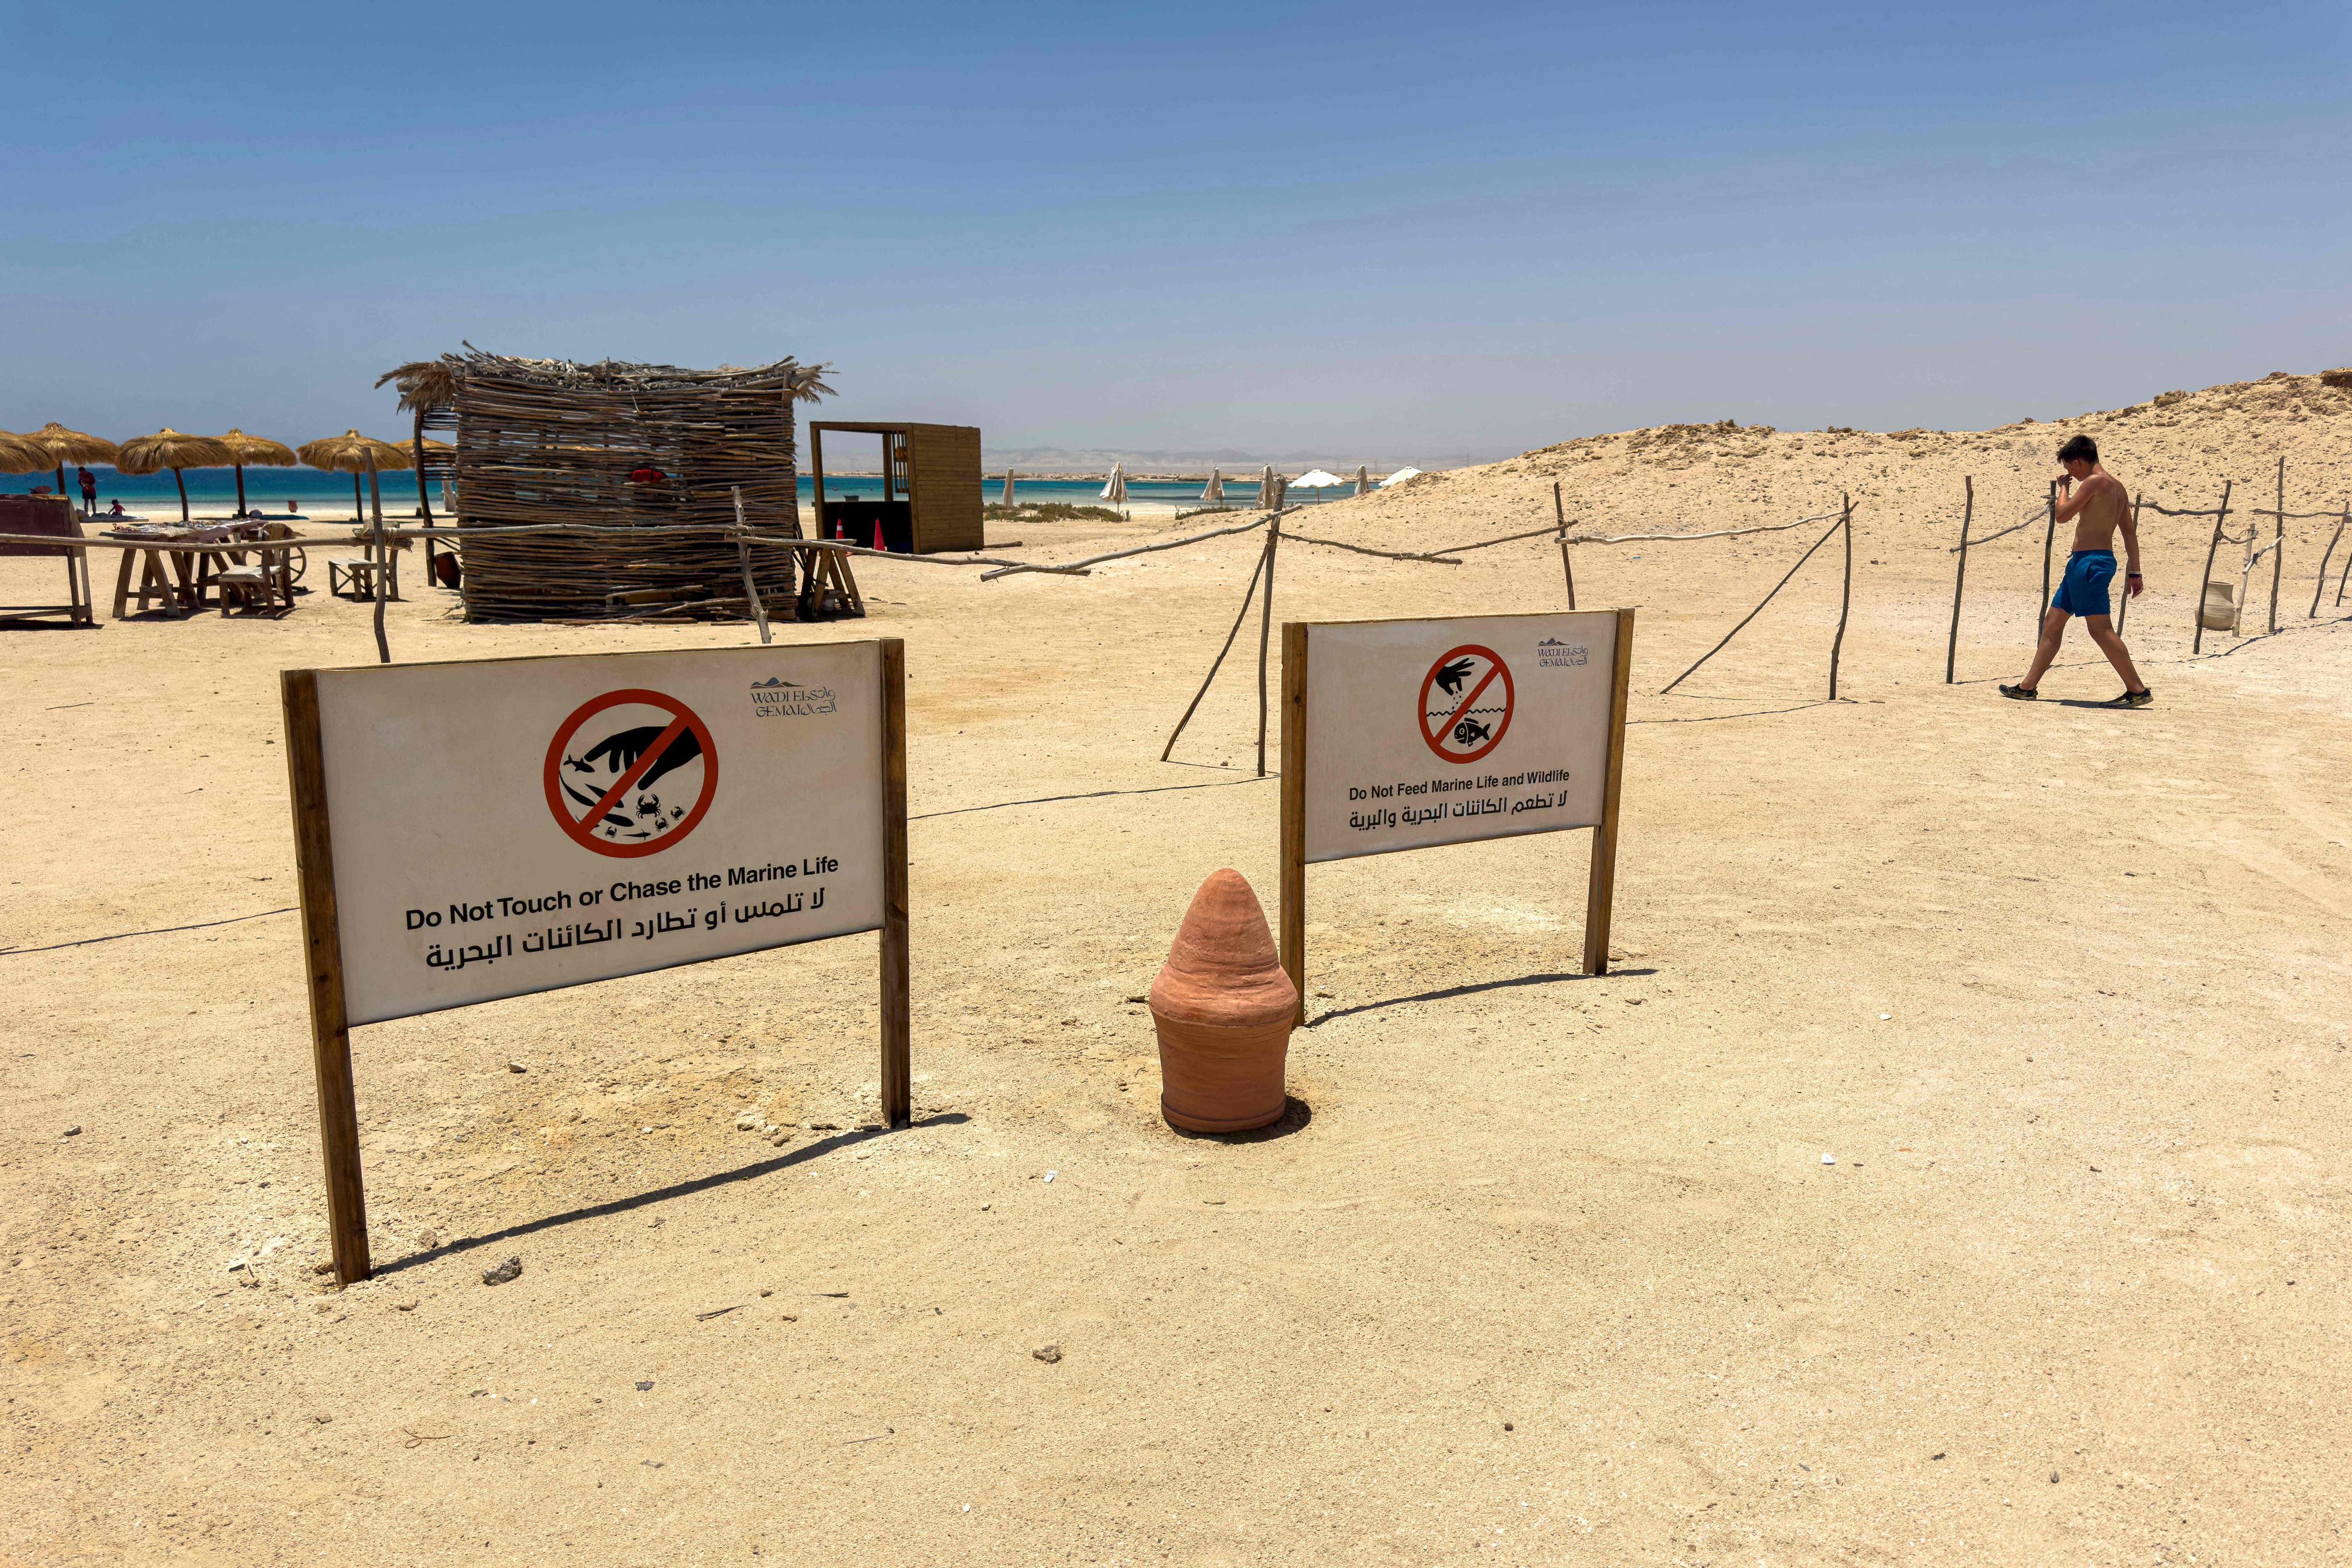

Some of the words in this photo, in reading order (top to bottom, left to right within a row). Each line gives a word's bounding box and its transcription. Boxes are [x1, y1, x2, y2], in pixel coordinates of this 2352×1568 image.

[1538, 648, 1561, 657] WADI
[750, 691, 789, 704] WADI
[1349, 787, 1367, 801] Do
[1371, 785, 1394, 798] Not
[1397, 781, 1428, 796] Feed
[1431, 778, 1473, 793] Marine
[1476, 775, 1499, 789] Life
[1502, 773, 1524, 787] and
[1526, 769, 1570, 784] Wildlife
[1452, 797, 1507, 818] الكائنات
[1511, 793, 1555, 815] تطعم
[1557, 790, 1568, 807] لا
[1349, 808, 1396, 831] والبرية
[1401, 803, 1448, 826] البحرية
[406, 909, 442, 930] Do
[450, 901, 494, 924] Not
[496, 890, 572, 917] Touch
[579, 889, 604, 906] or
[610, 880, 682, 902] Chase
[687, 872, 722, 892] the
[728, 863, 798, 886] Marine
[803, 855, 839, 876] Life
[810, 887, 826, 910] لا
[704, 901, 727, 931] أو
[734, 892, 804, 924] تلمس
[522, 918, 622, 953] الكائنات
[631, 908, 698, 940] تطارد
[426, 934, 512, 971] البحرية
